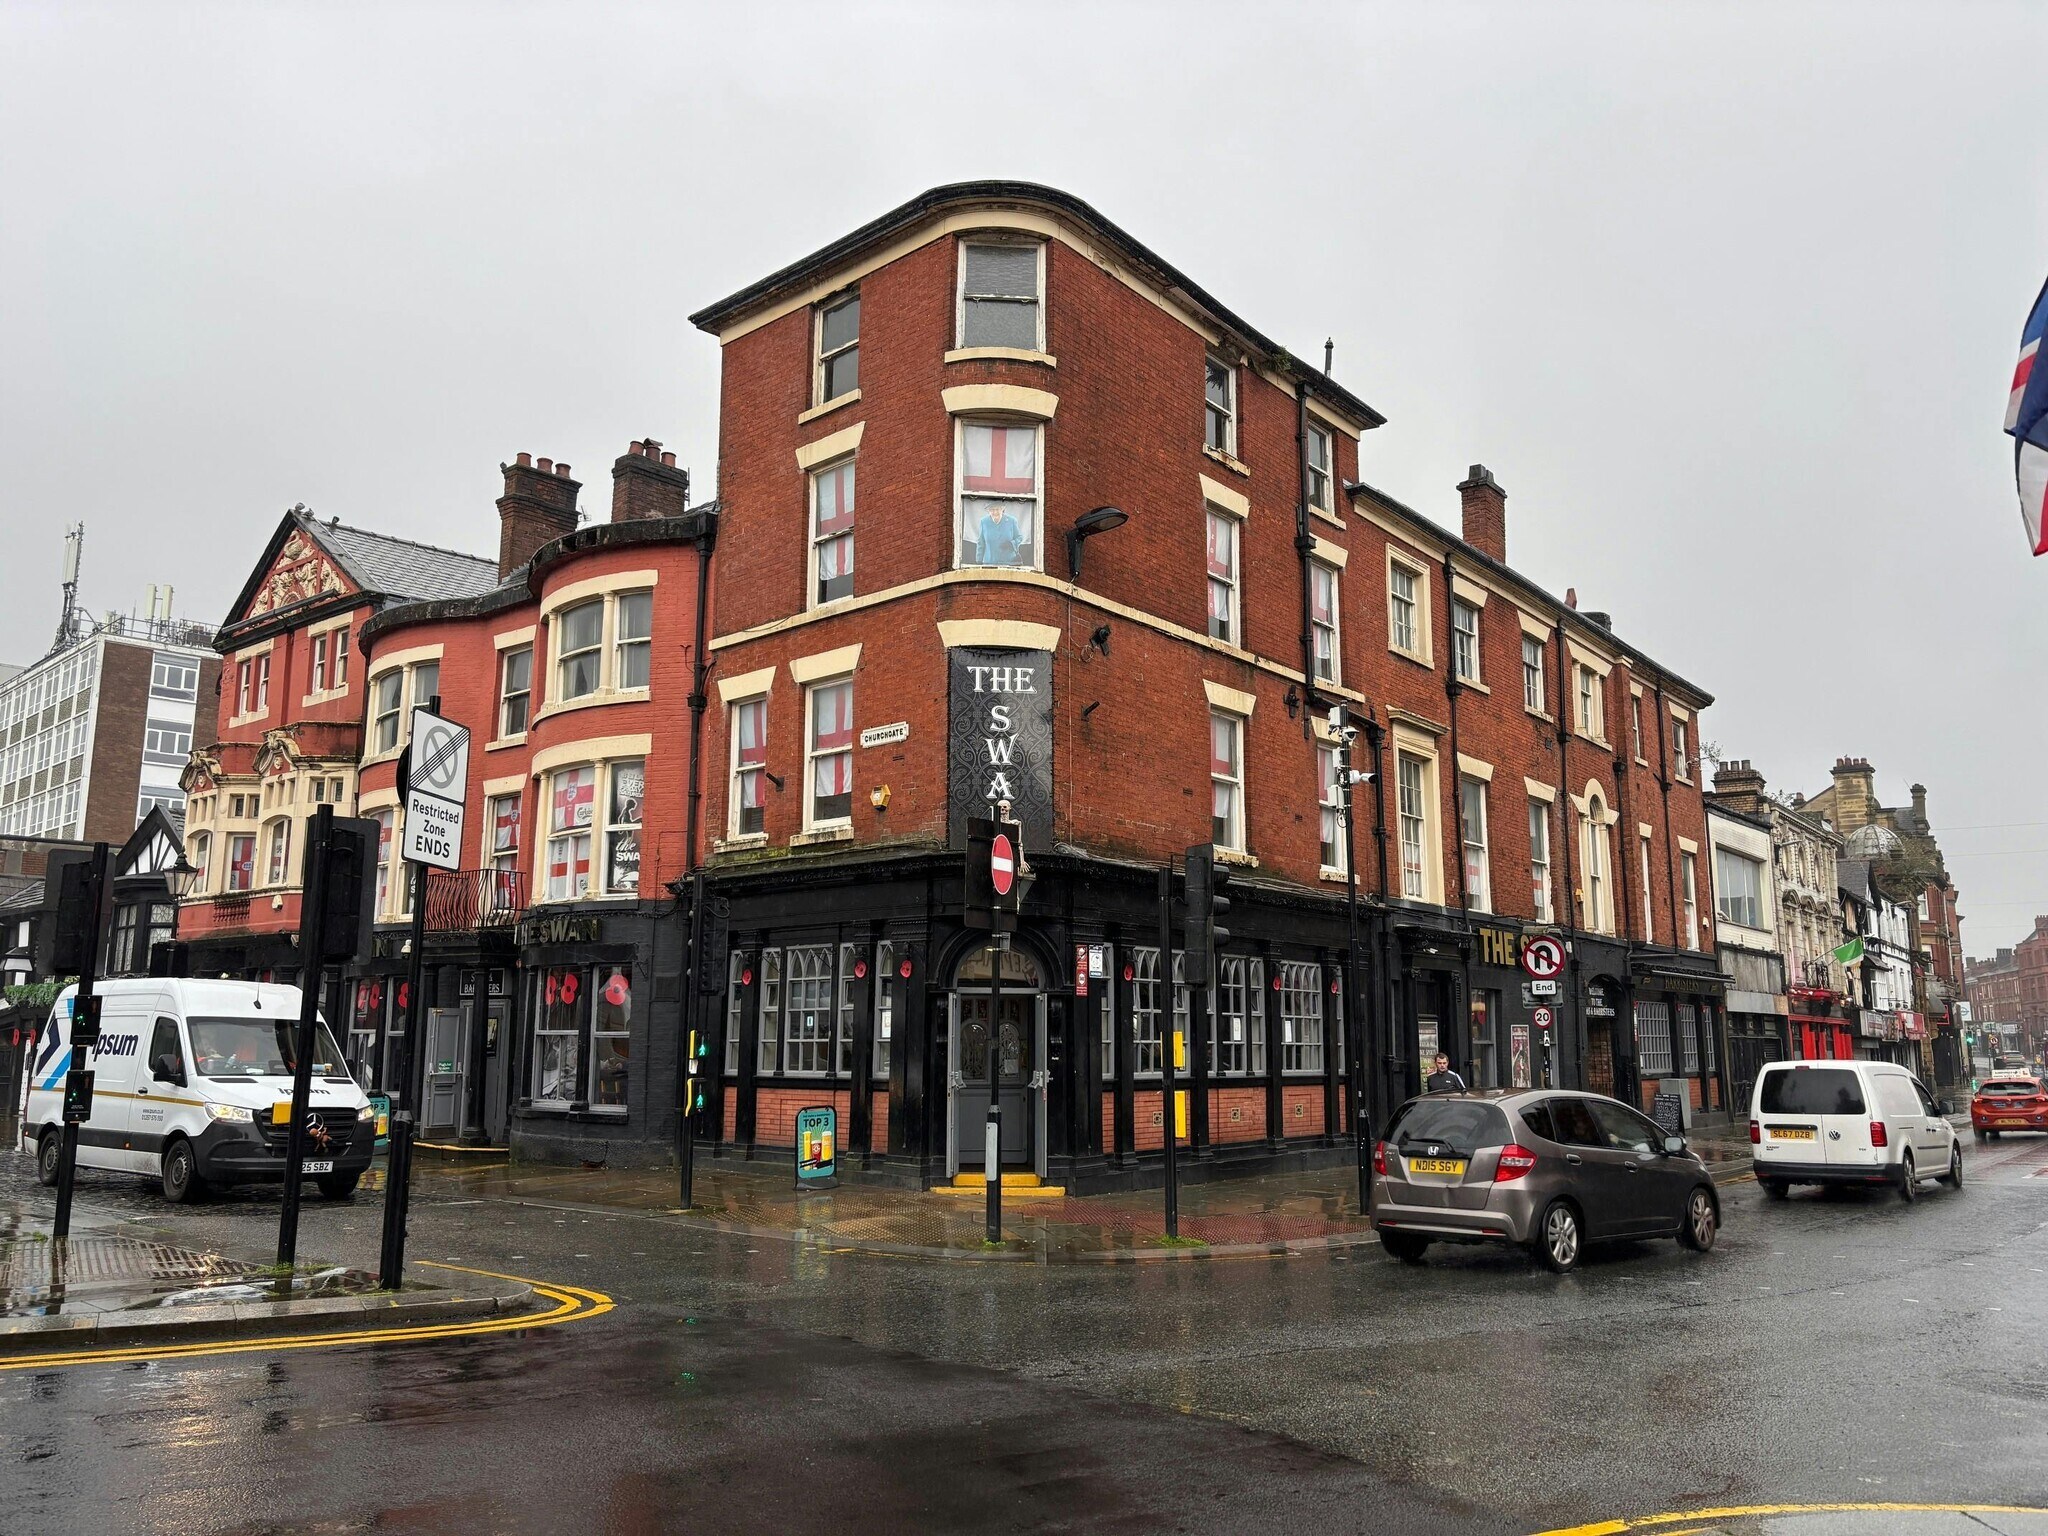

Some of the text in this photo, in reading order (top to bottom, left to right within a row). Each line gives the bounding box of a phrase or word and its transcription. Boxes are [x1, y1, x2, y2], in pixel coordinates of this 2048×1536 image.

[966, 666, 1038, 694] THE
[864, 728, 904, 743] CHURCHGATE
[412, 798, 460, 824] Restricted
[423, 819, 446, 838] Zone
[415, 834, 451, 859] ENDS
[615, 852, 640, 862] SWA
[539, 916, 600, 944] SWAN
[1479, 927, 1516, 966] THE
[1535, 983, 1553, 992] End
[1536, 1012, 1550, 1022] 20
[803, 1116, 829, 1128] TOP 3
[1773, 1130, 1792, 1138] SL67
[302, 1162, 330, 1171] 25 SBZ
[1415, 1160, 1458, 1172] ND15 SGY
